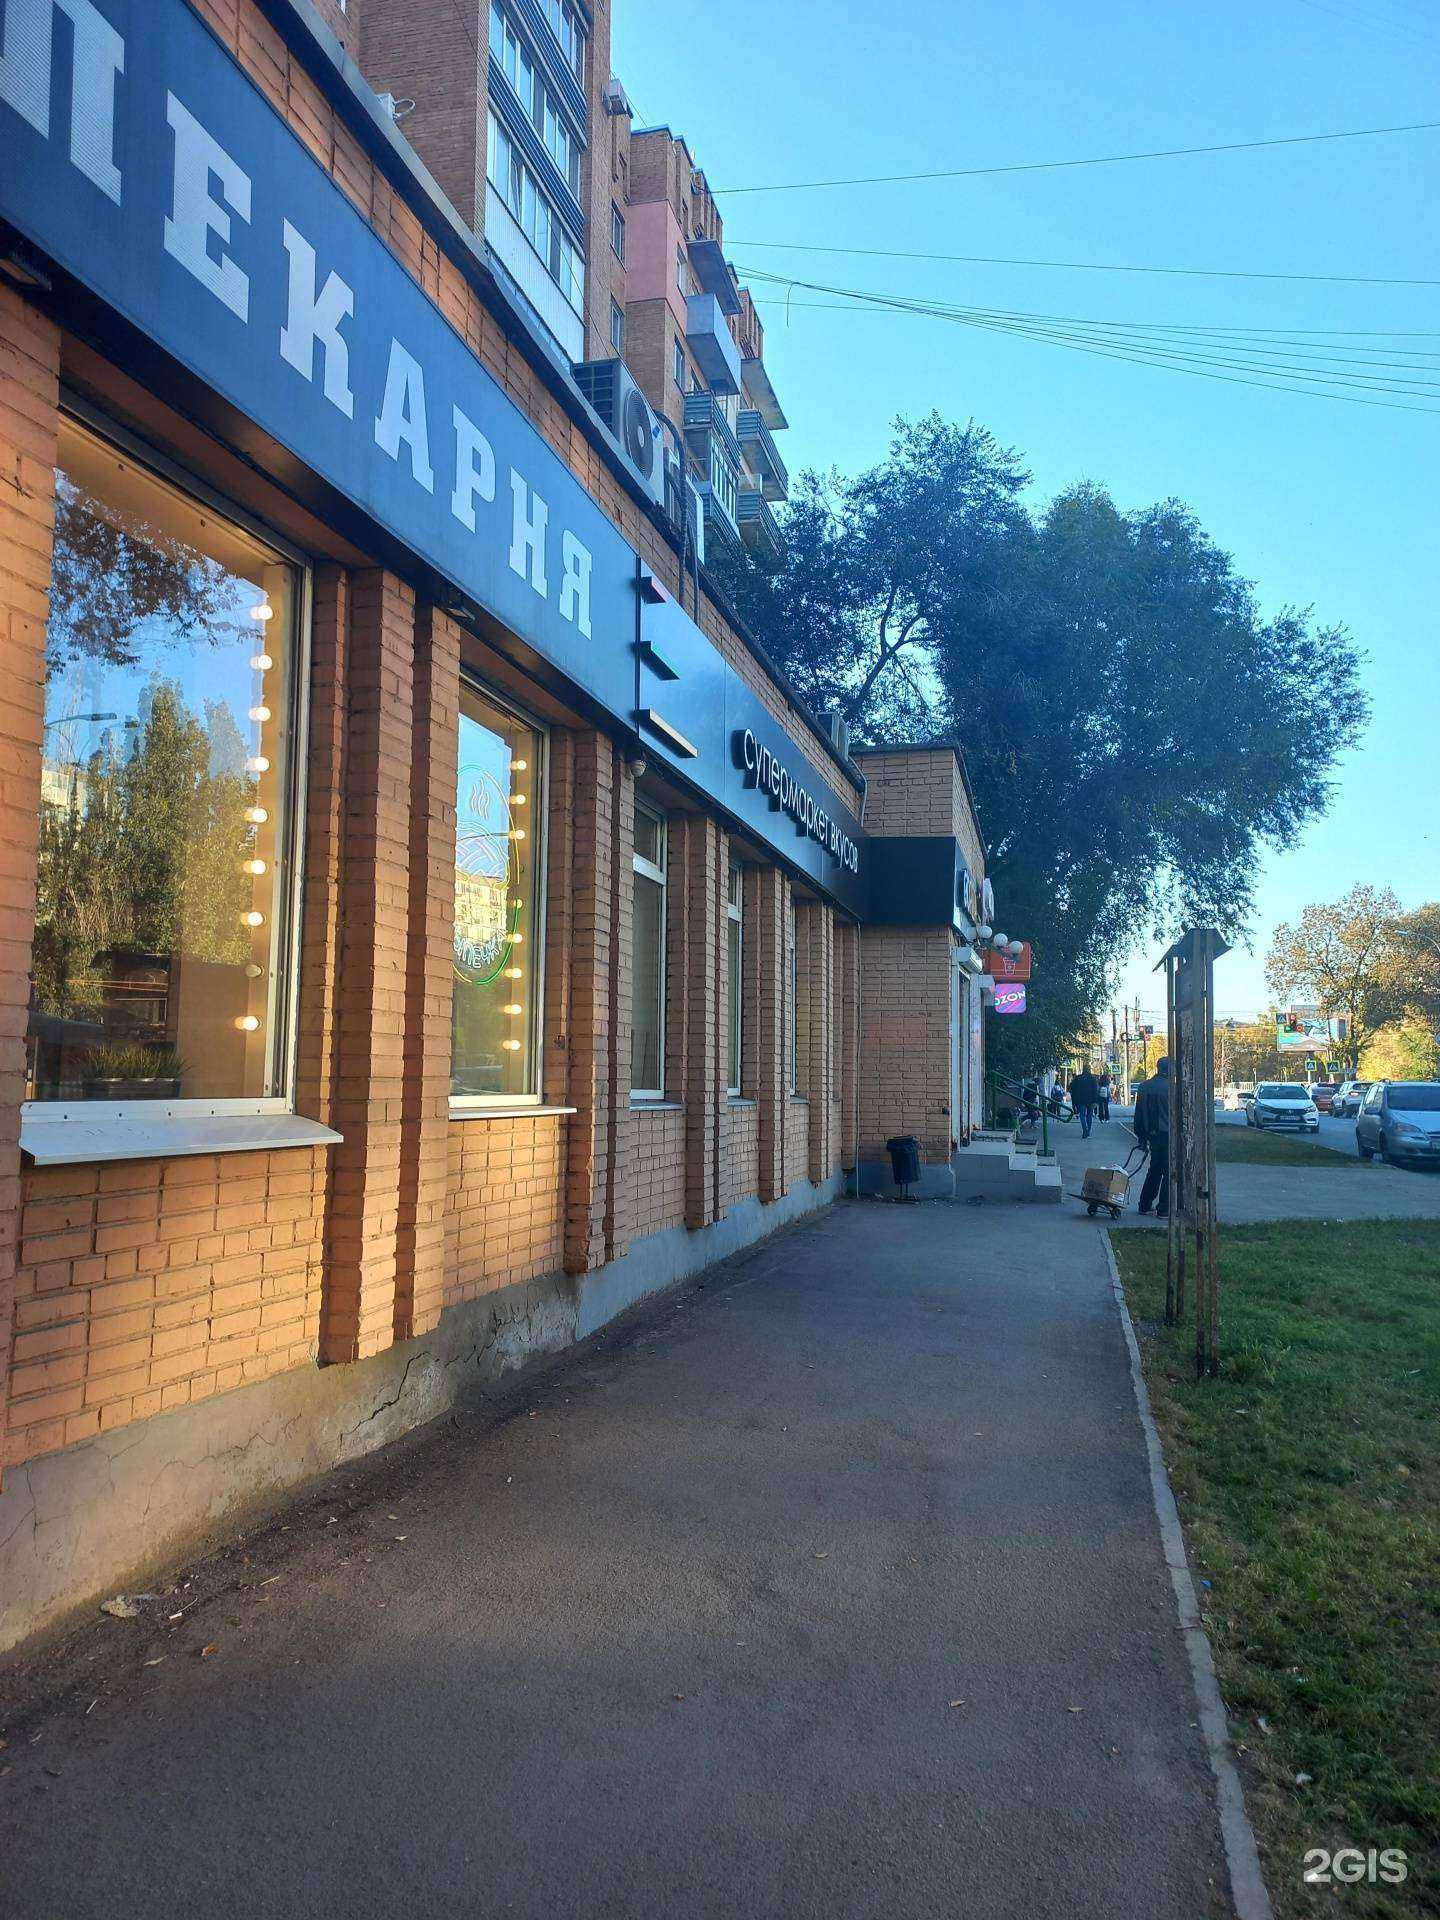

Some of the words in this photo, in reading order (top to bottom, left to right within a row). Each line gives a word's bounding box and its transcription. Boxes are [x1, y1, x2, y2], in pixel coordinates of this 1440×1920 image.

[0, 0, 592, 640] ПЕКАРНЯ
[744, 728, 829, 845] супермаркет
[831, 822, 858, 873] вкусов
